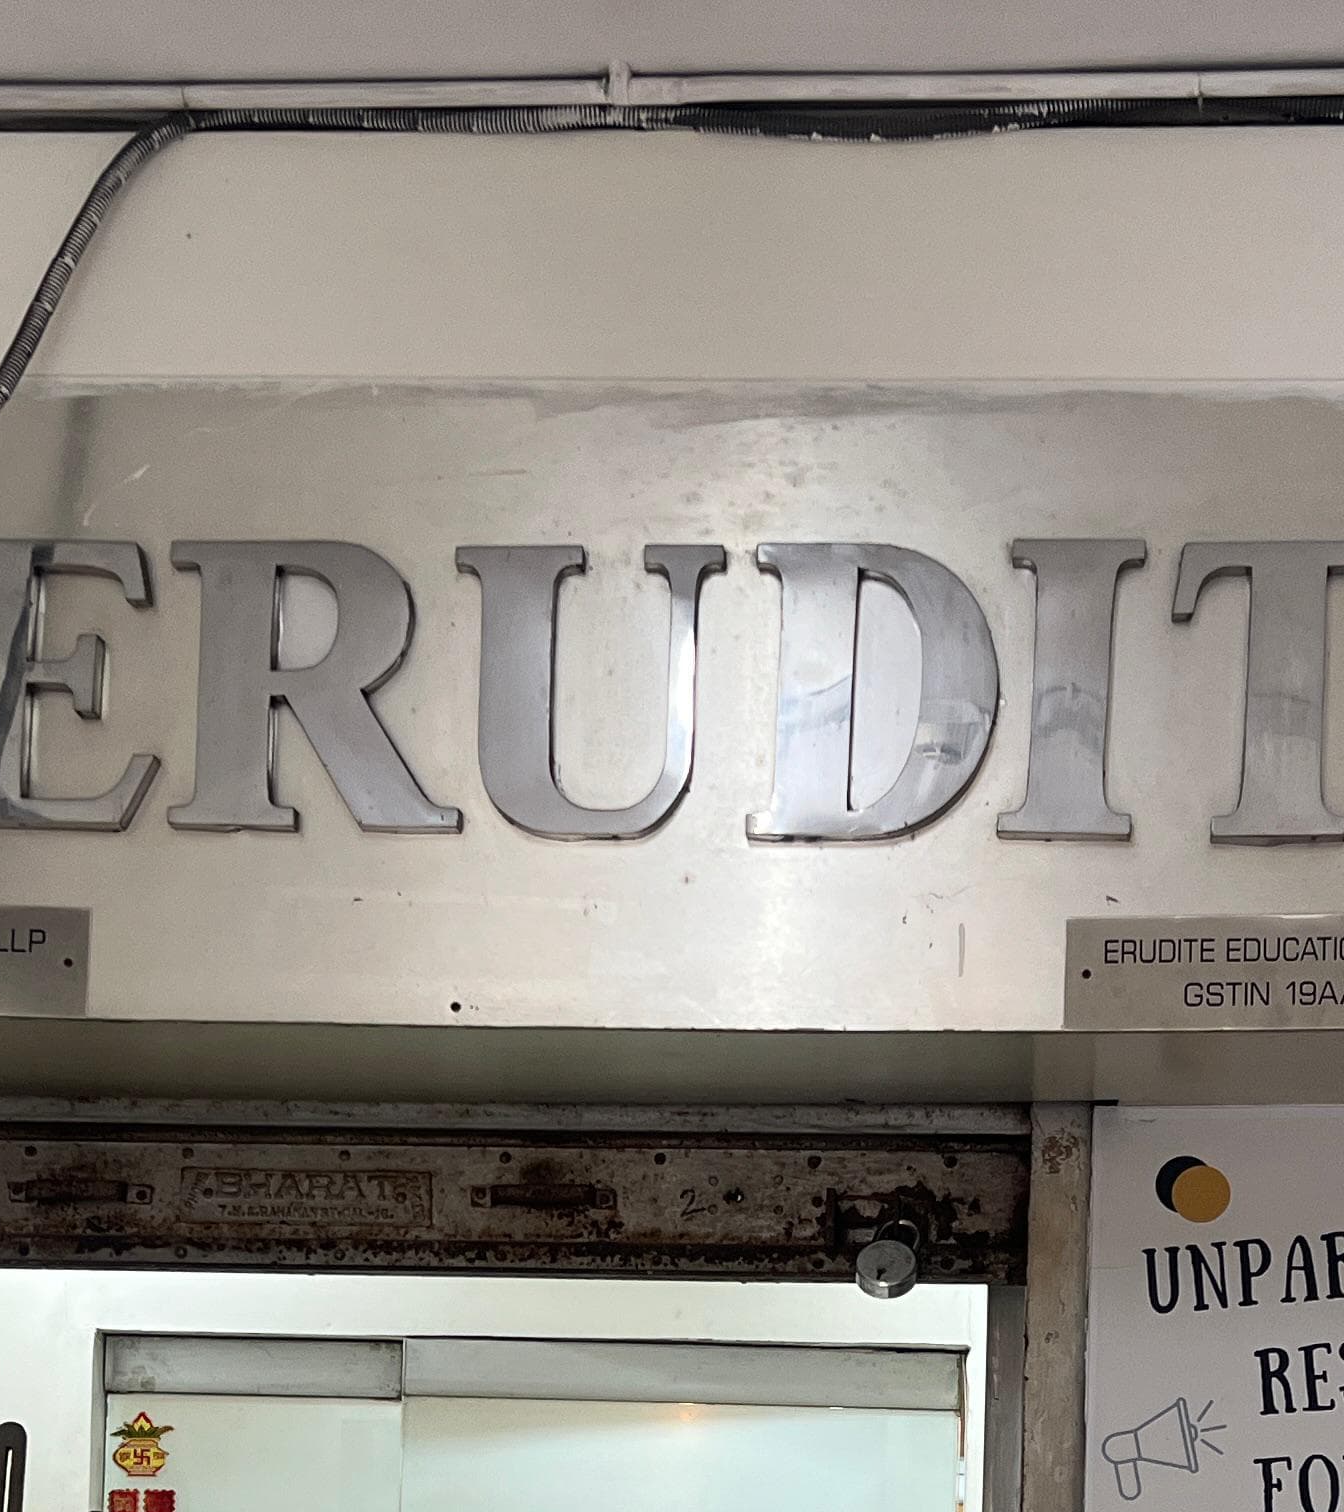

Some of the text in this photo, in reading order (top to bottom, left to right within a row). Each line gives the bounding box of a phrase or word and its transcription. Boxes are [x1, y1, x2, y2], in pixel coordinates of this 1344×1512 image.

[1104, 939, 1215, 964] ERUDITE
[1183, 983, 1270, 1007] GSTIN
[214, 1171, 398, 1201] BHARAT
